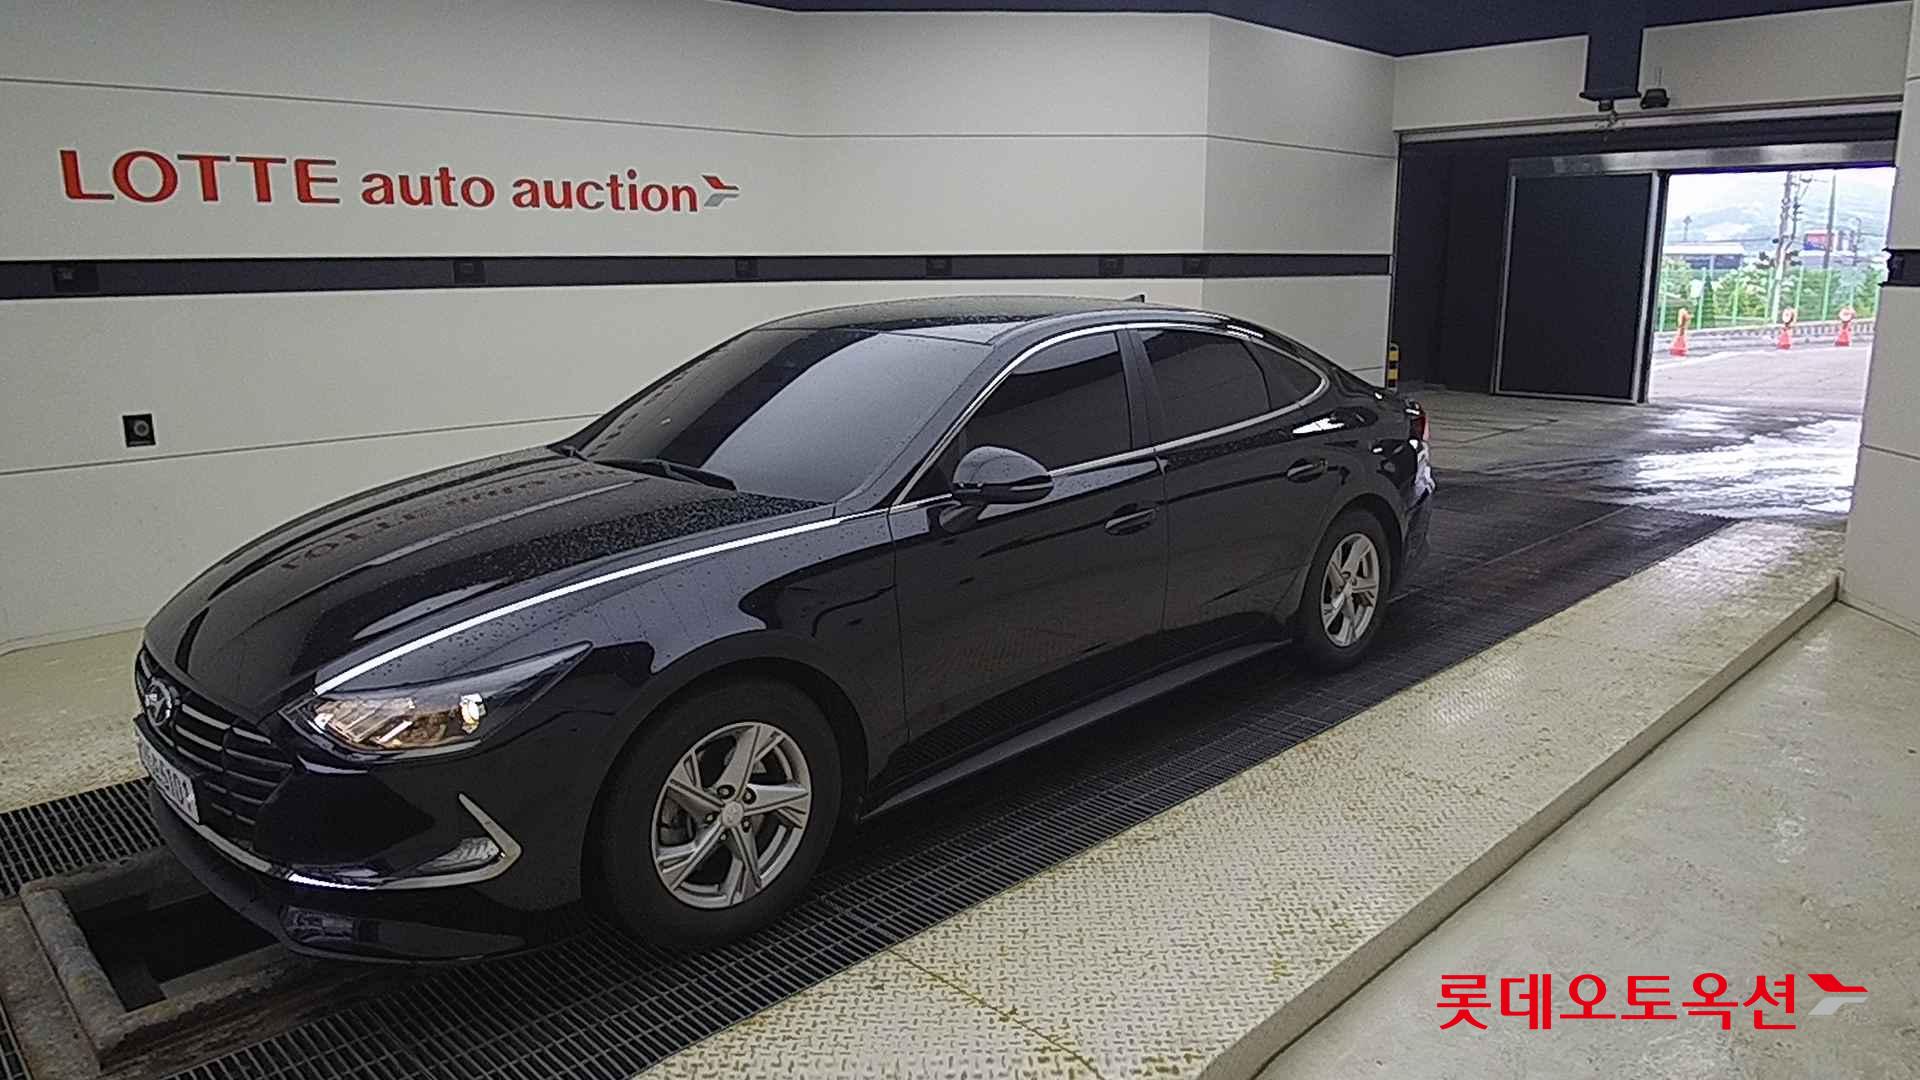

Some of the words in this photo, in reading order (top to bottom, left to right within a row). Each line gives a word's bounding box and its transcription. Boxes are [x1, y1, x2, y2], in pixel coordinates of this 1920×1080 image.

[60, 149, 338, 204] LOTTE
[361, 167, 495, 207] auto
[511, 169, 698, 212] auction
